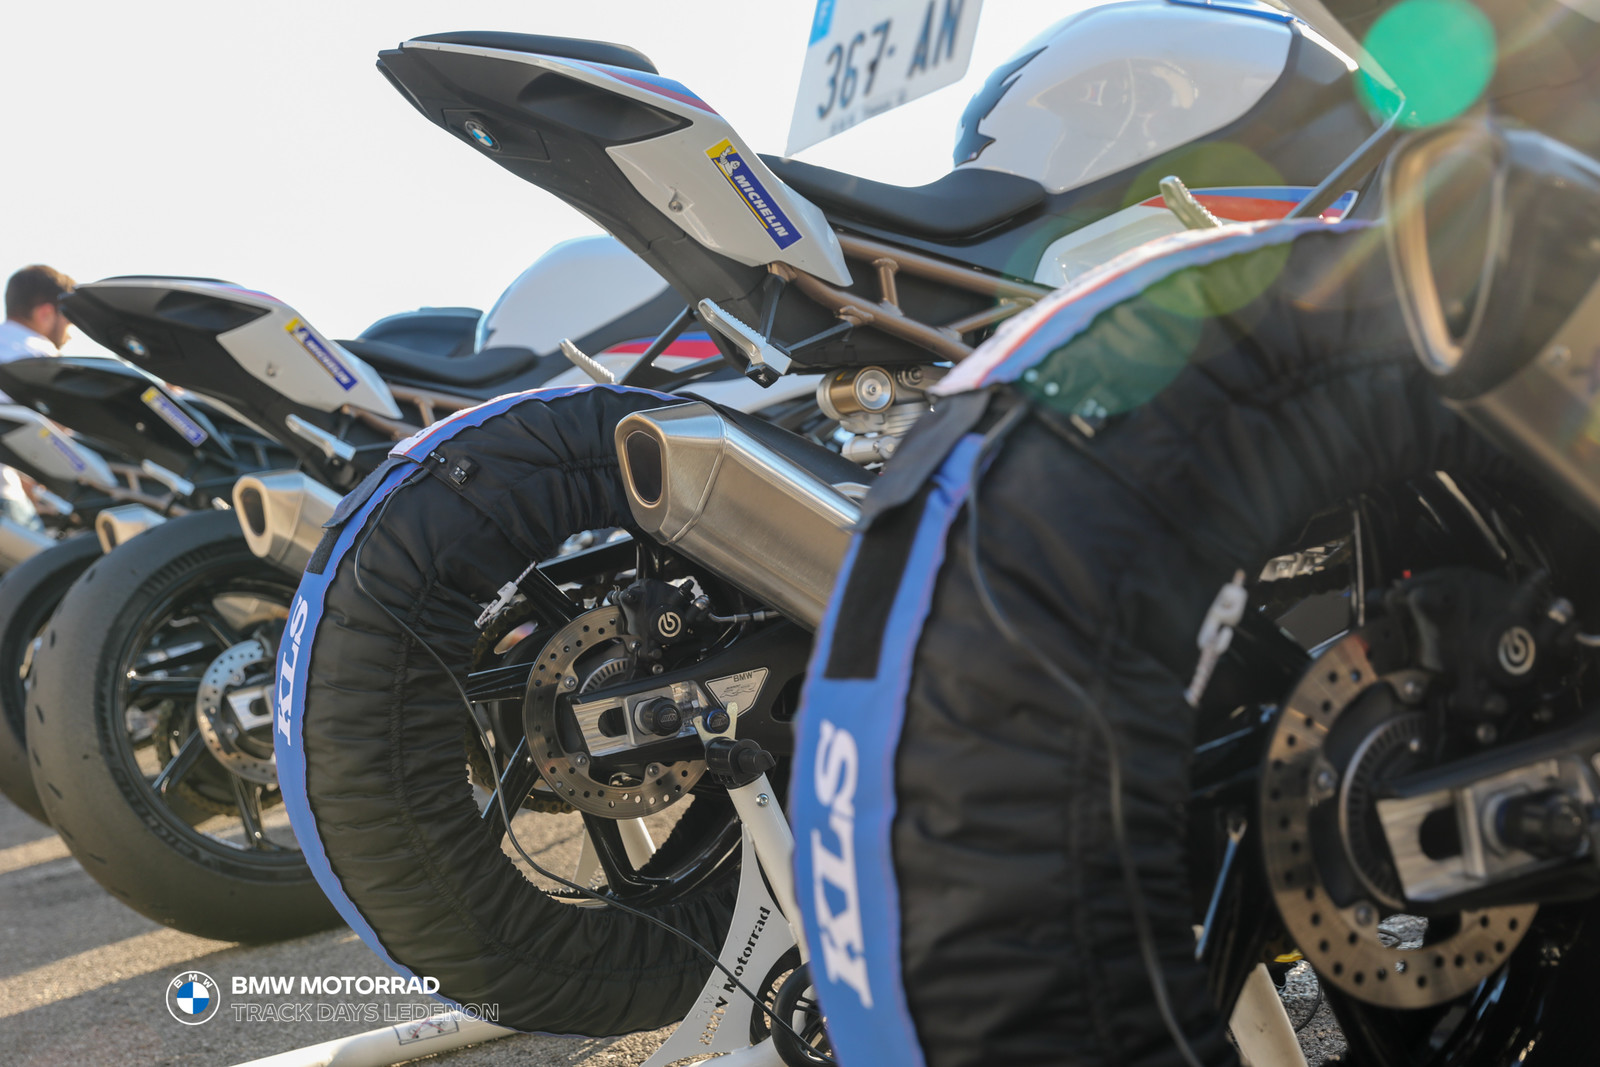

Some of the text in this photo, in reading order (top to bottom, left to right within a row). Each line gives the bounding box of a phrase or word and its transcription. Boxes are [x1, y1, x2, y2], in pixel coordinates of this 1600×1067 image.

[734, 174, 789, 238] MICHELIN
[278, 595, 308, 746] KLS
[733, 672, 753, 682] BMW
[811, 719, 874, 1009] KLS
[723, 906, 771, 993] Motorrad
